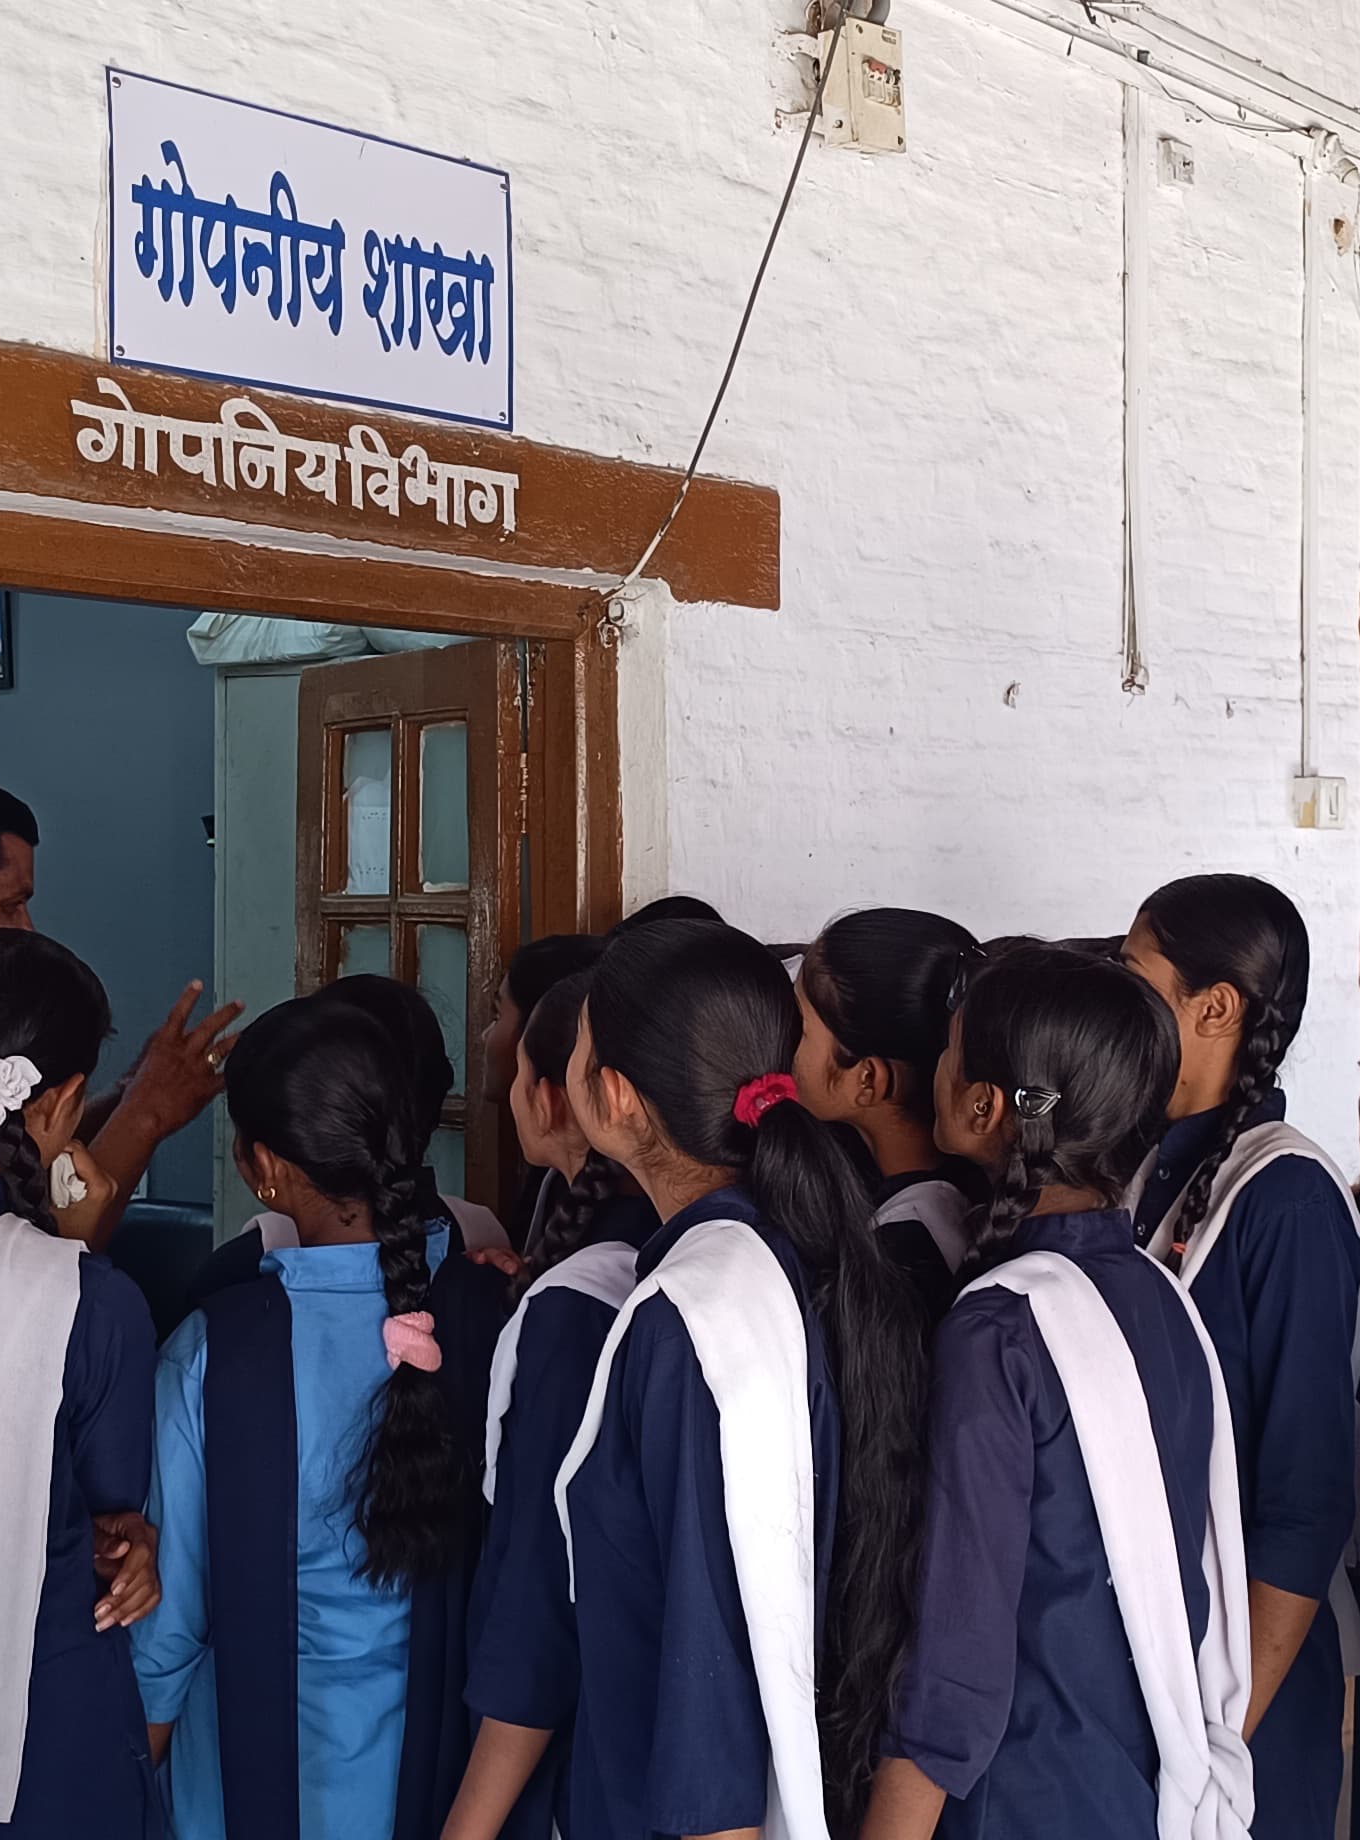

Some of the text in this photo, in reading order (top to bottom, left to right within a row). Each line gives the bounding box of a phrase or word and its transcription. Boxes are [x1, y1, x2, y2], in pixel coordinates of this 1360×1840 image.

[132, 140, 494, 364] गोपनीय शाखा
[71, 377, 520, 533] गोपनिय विभाग
